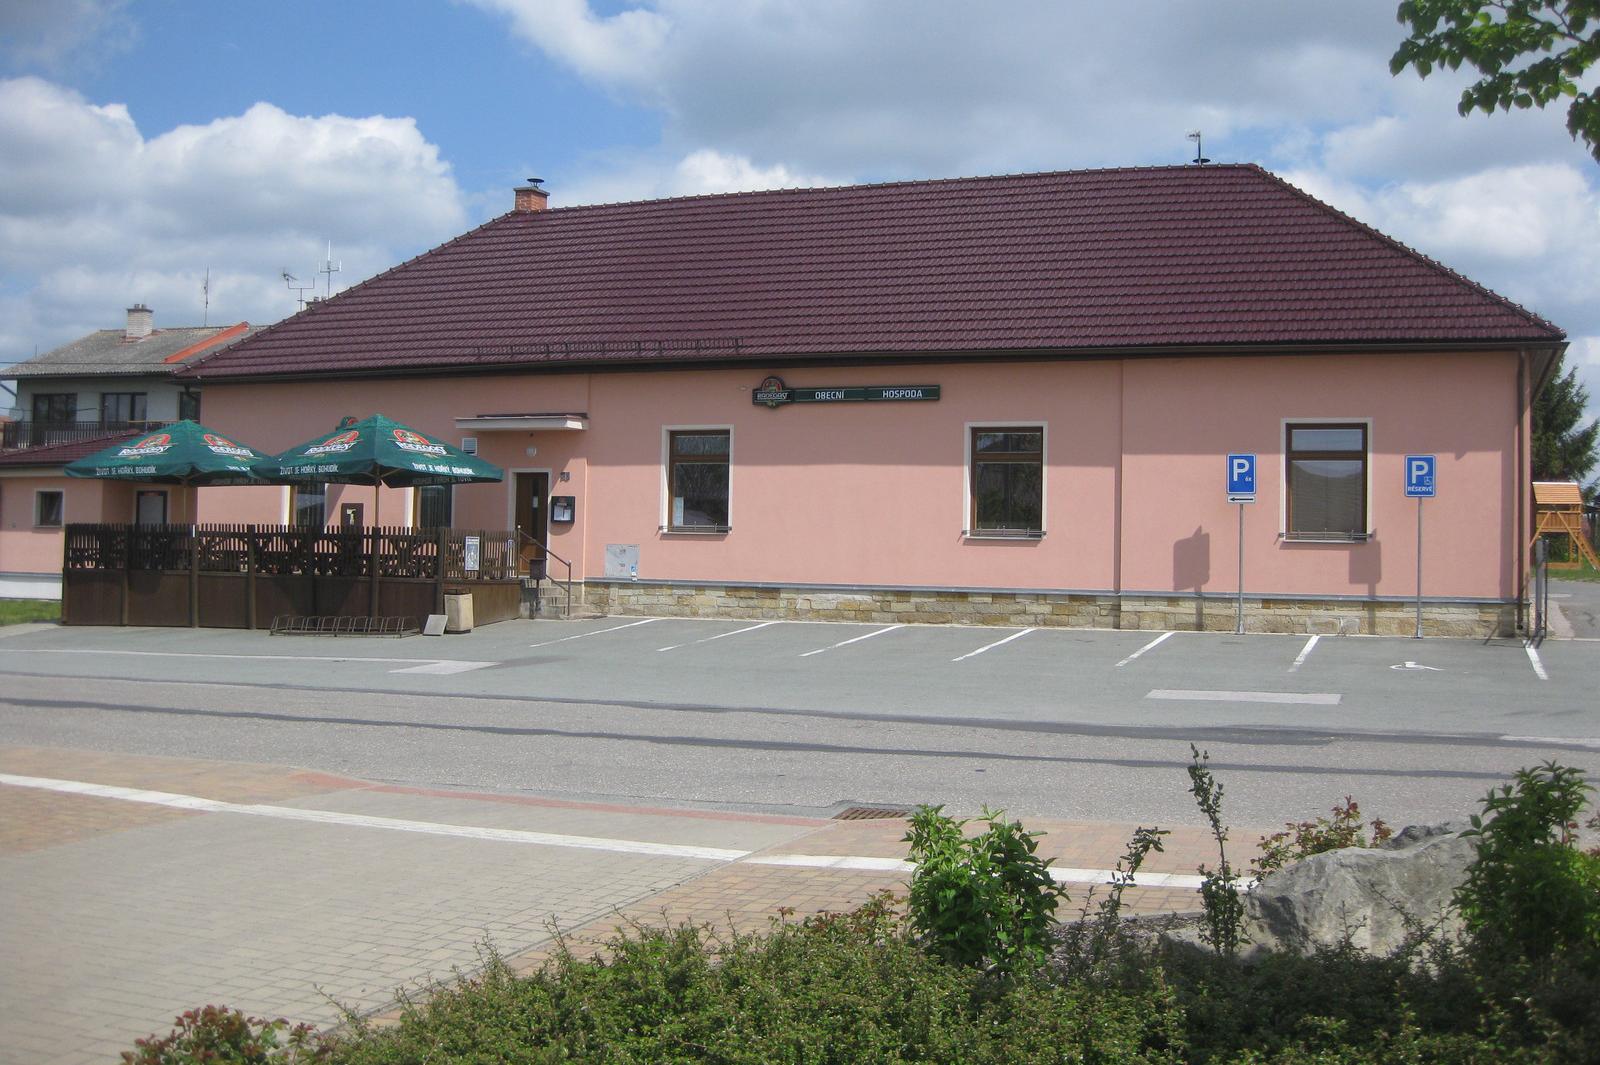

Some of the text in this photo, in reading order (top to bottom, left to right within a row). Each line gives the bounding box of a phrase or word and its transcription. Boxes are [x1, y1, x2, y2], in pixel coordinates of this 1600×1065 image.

[815, 389, 845, 400] OBECNÍ
[882, 389, 923, 399] HOSPODA
[1233, 459, 1249, 481] P
[1411, 461, 1428, 484] P
